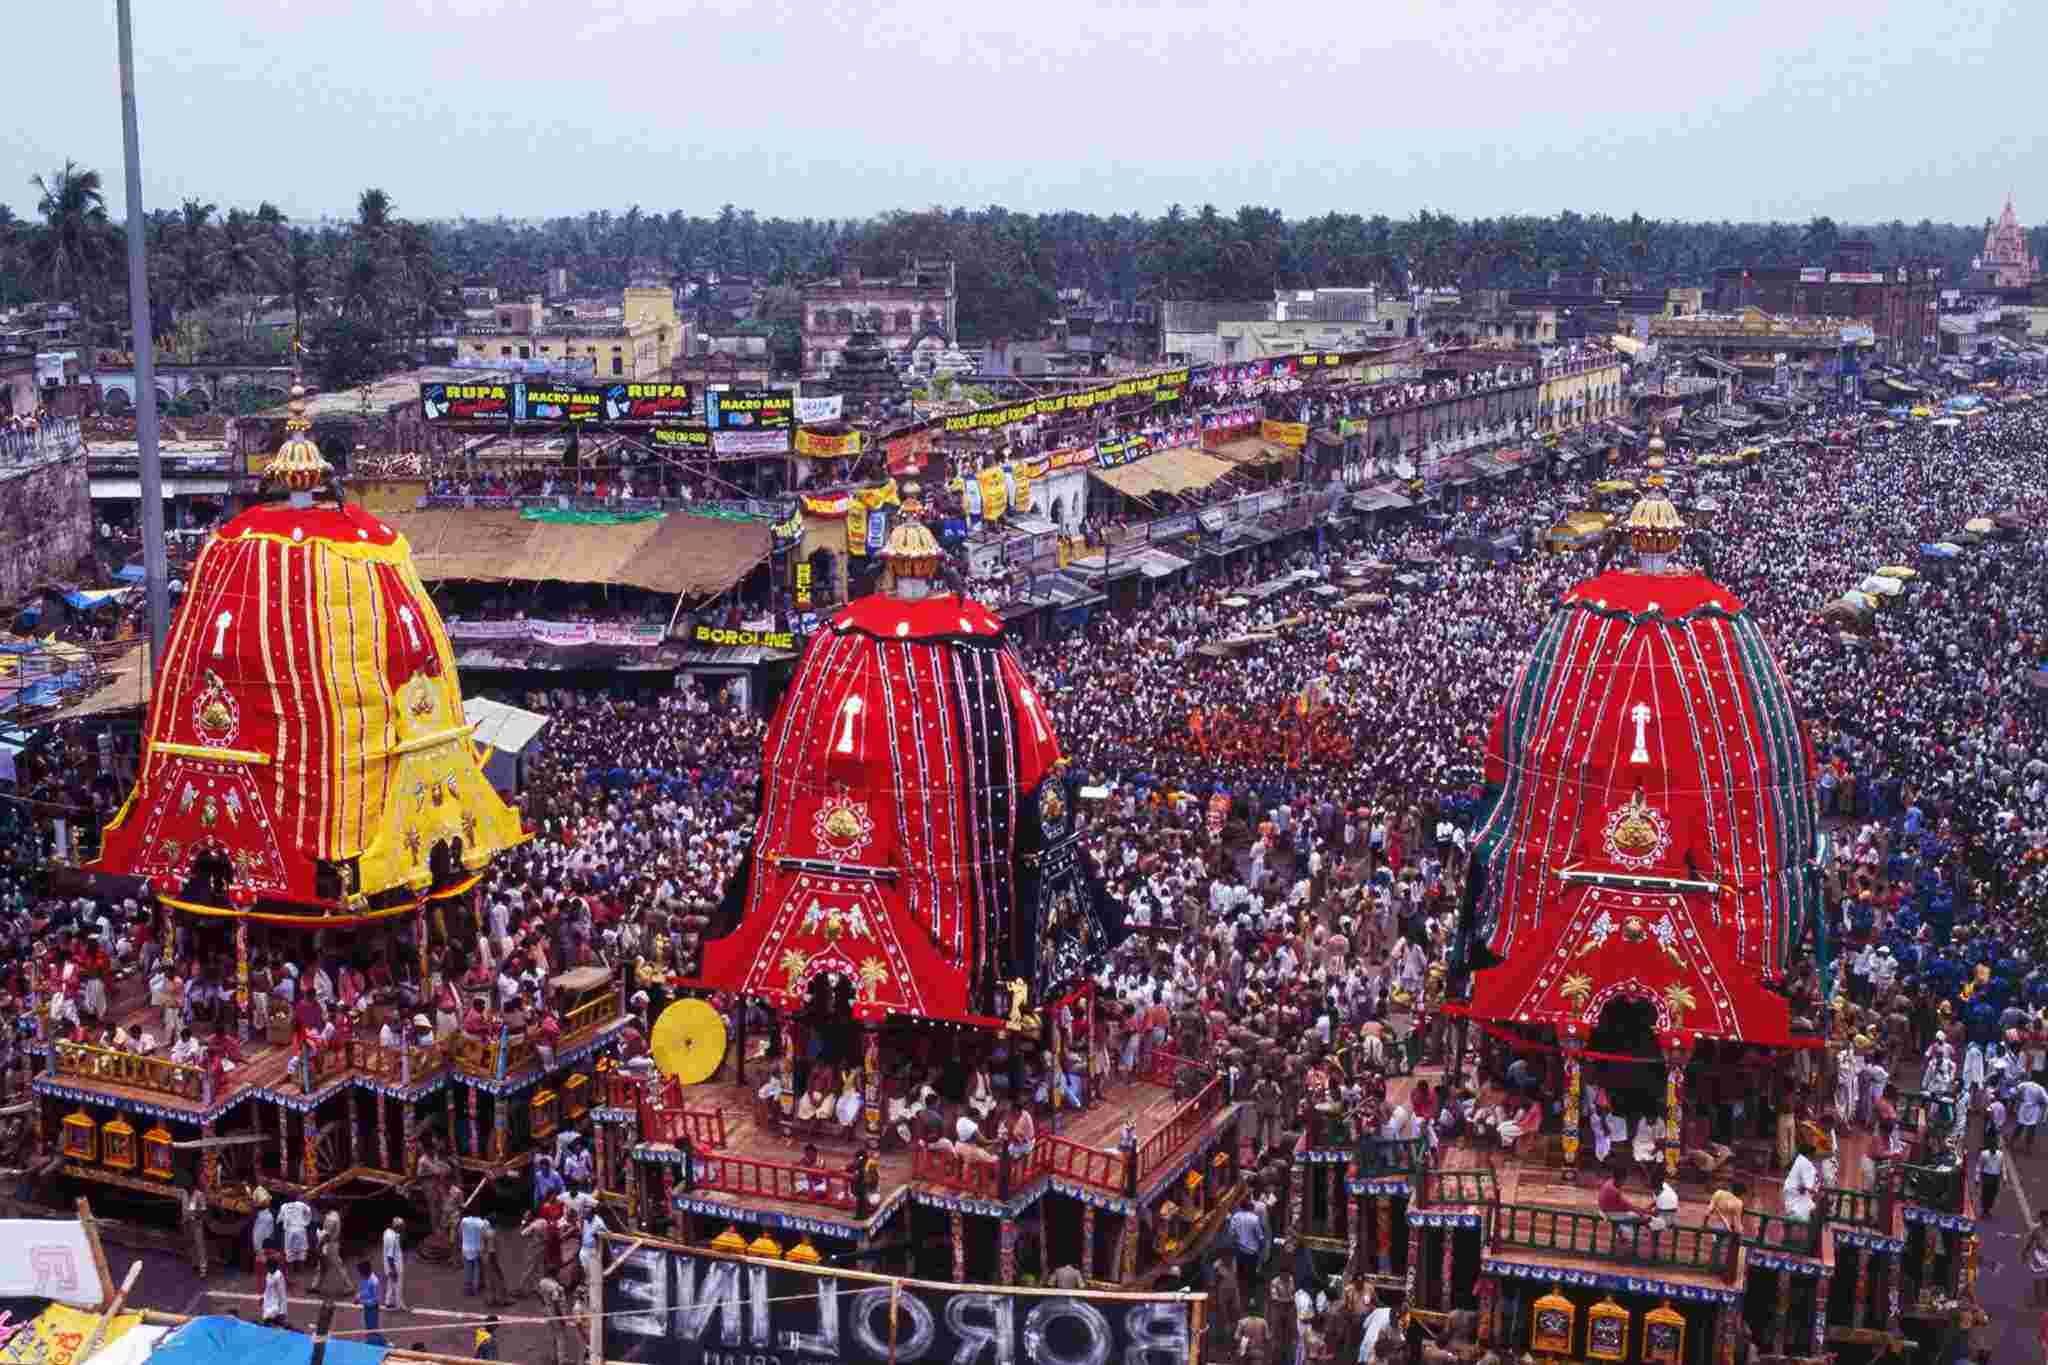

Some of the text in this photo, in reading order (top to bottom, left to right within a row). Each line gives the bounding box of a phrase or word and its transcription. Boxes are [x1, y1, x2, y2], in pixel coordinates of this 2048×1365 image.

[446, 386, 506, 399] RUPA
[627, 384, 687, 398] RUPA
[528, 392, 600, 405] MACRO MAN
[719, 399, 761, 411] MACRO
[762, 398, 791, 410] MAN
[696, 625, 795, 649] BOROLINE
